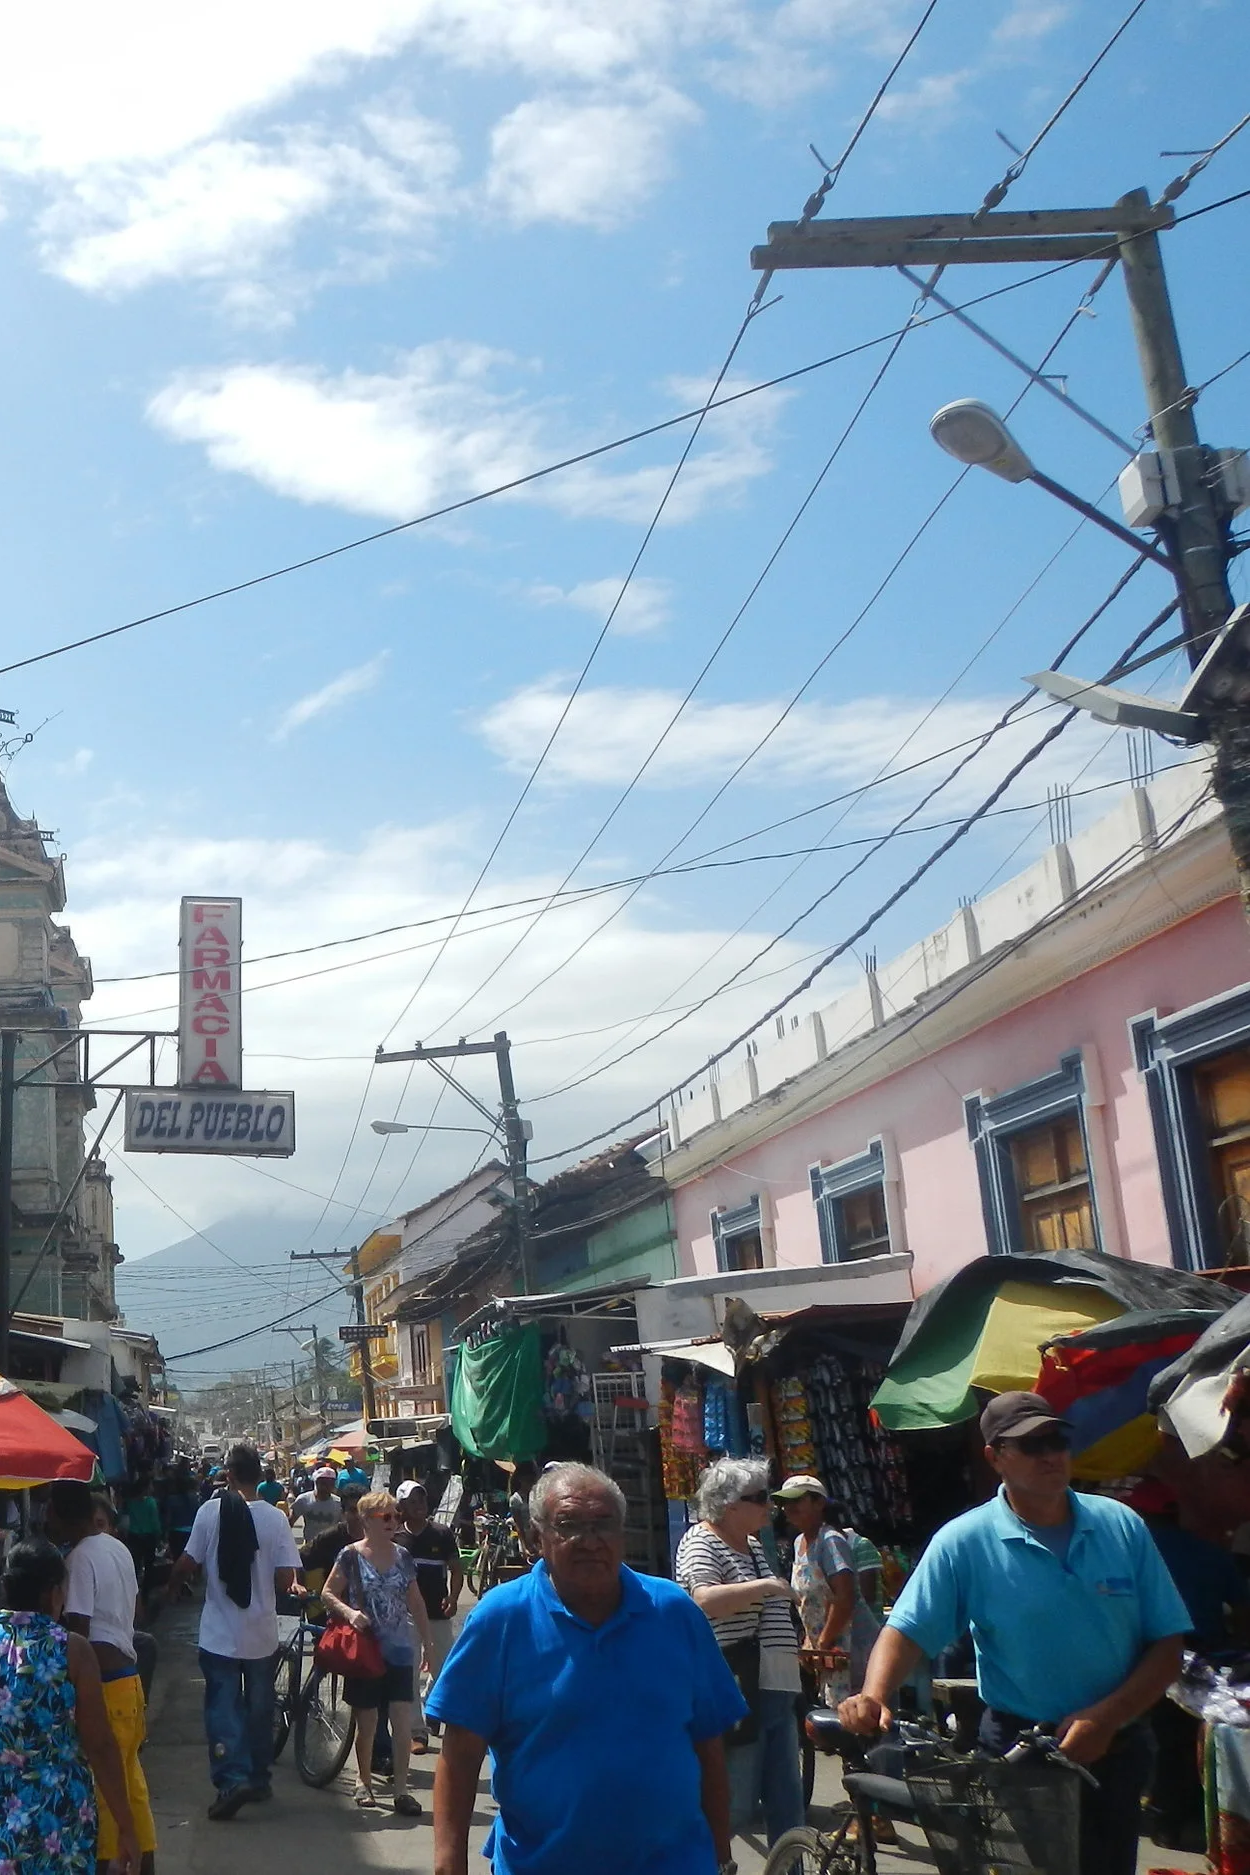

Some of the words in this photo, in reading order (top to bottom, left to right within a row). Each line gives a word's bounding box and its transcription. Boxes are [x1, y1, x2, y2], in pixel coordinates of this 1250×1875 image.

[191, 905, 231, 1083] FARMACIA
[136, 1101, 182, 1139] DEL
[185, 1102, 286, 1142] PUEBLO
